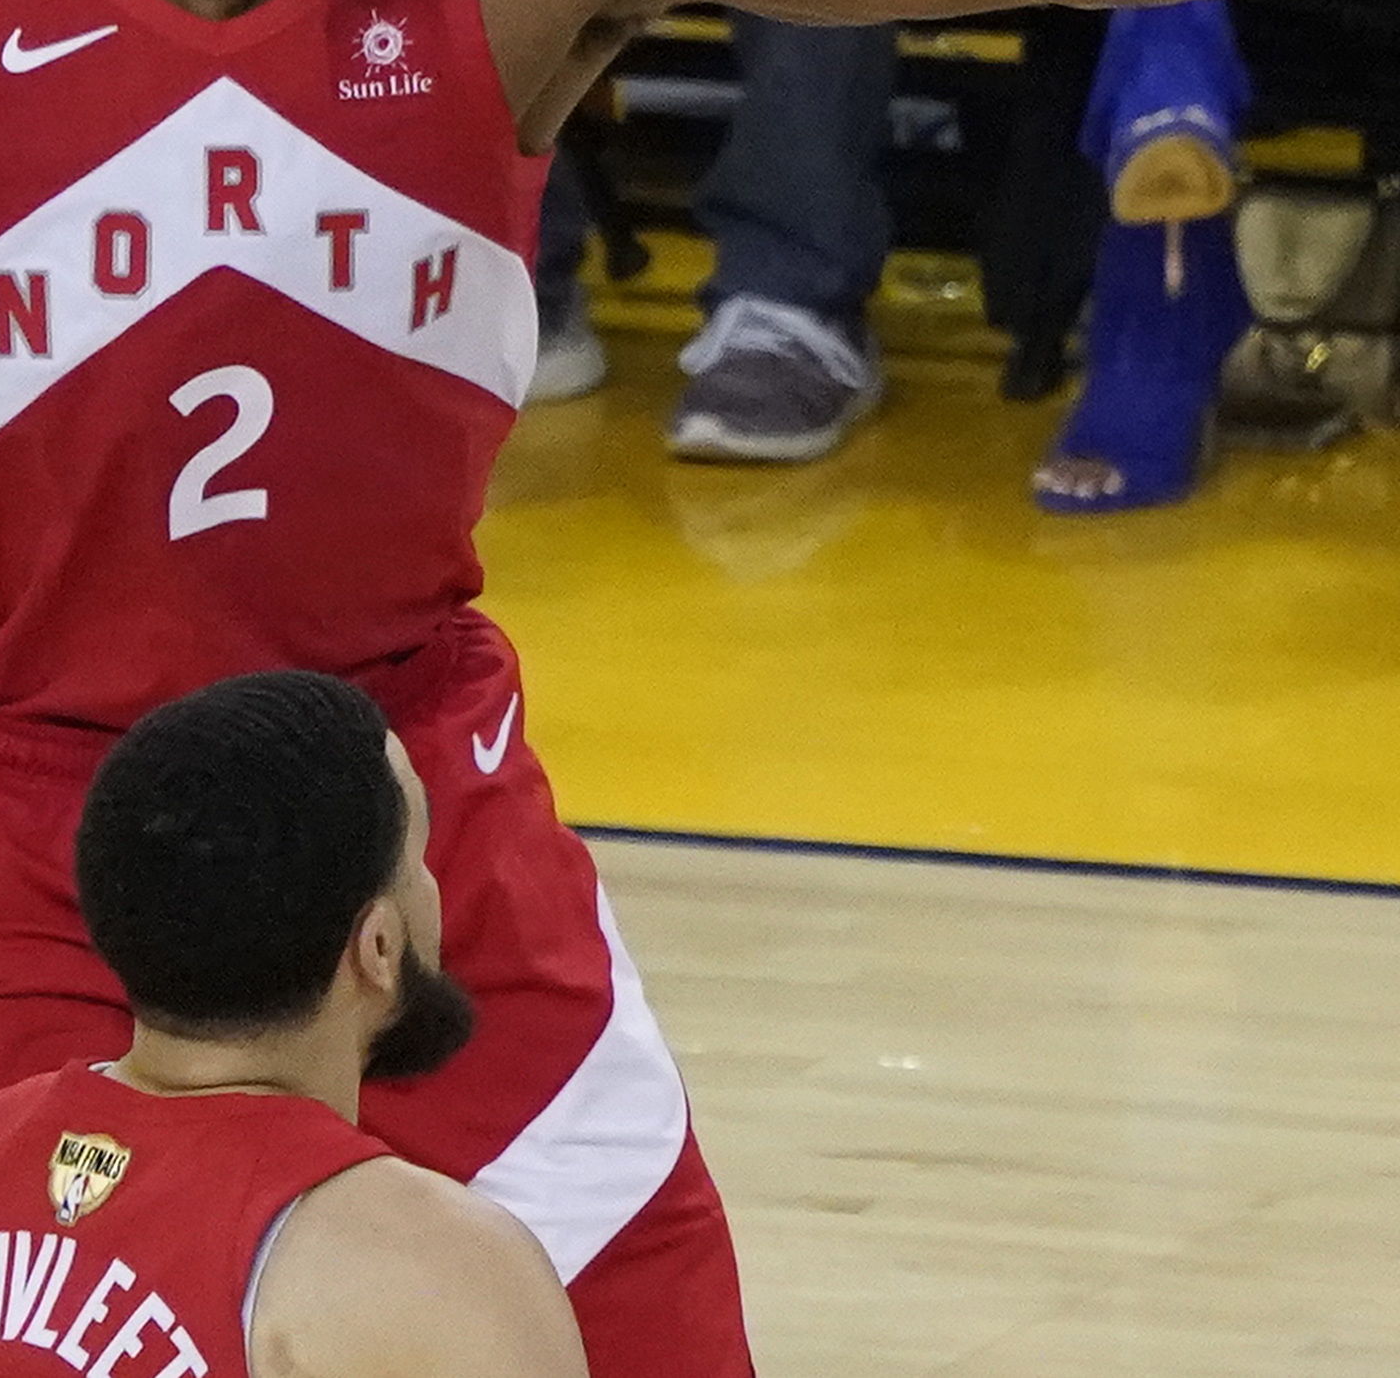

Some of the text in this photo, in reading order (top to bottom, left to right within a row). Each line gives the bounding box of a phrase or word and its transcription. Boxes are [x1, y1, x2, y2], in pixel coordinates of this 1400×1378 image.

[338, 70, 433, 100] Sun Life
[167, 363, 275, 543] 2
[56, 1138, 127, 1180] NBA FINALS
